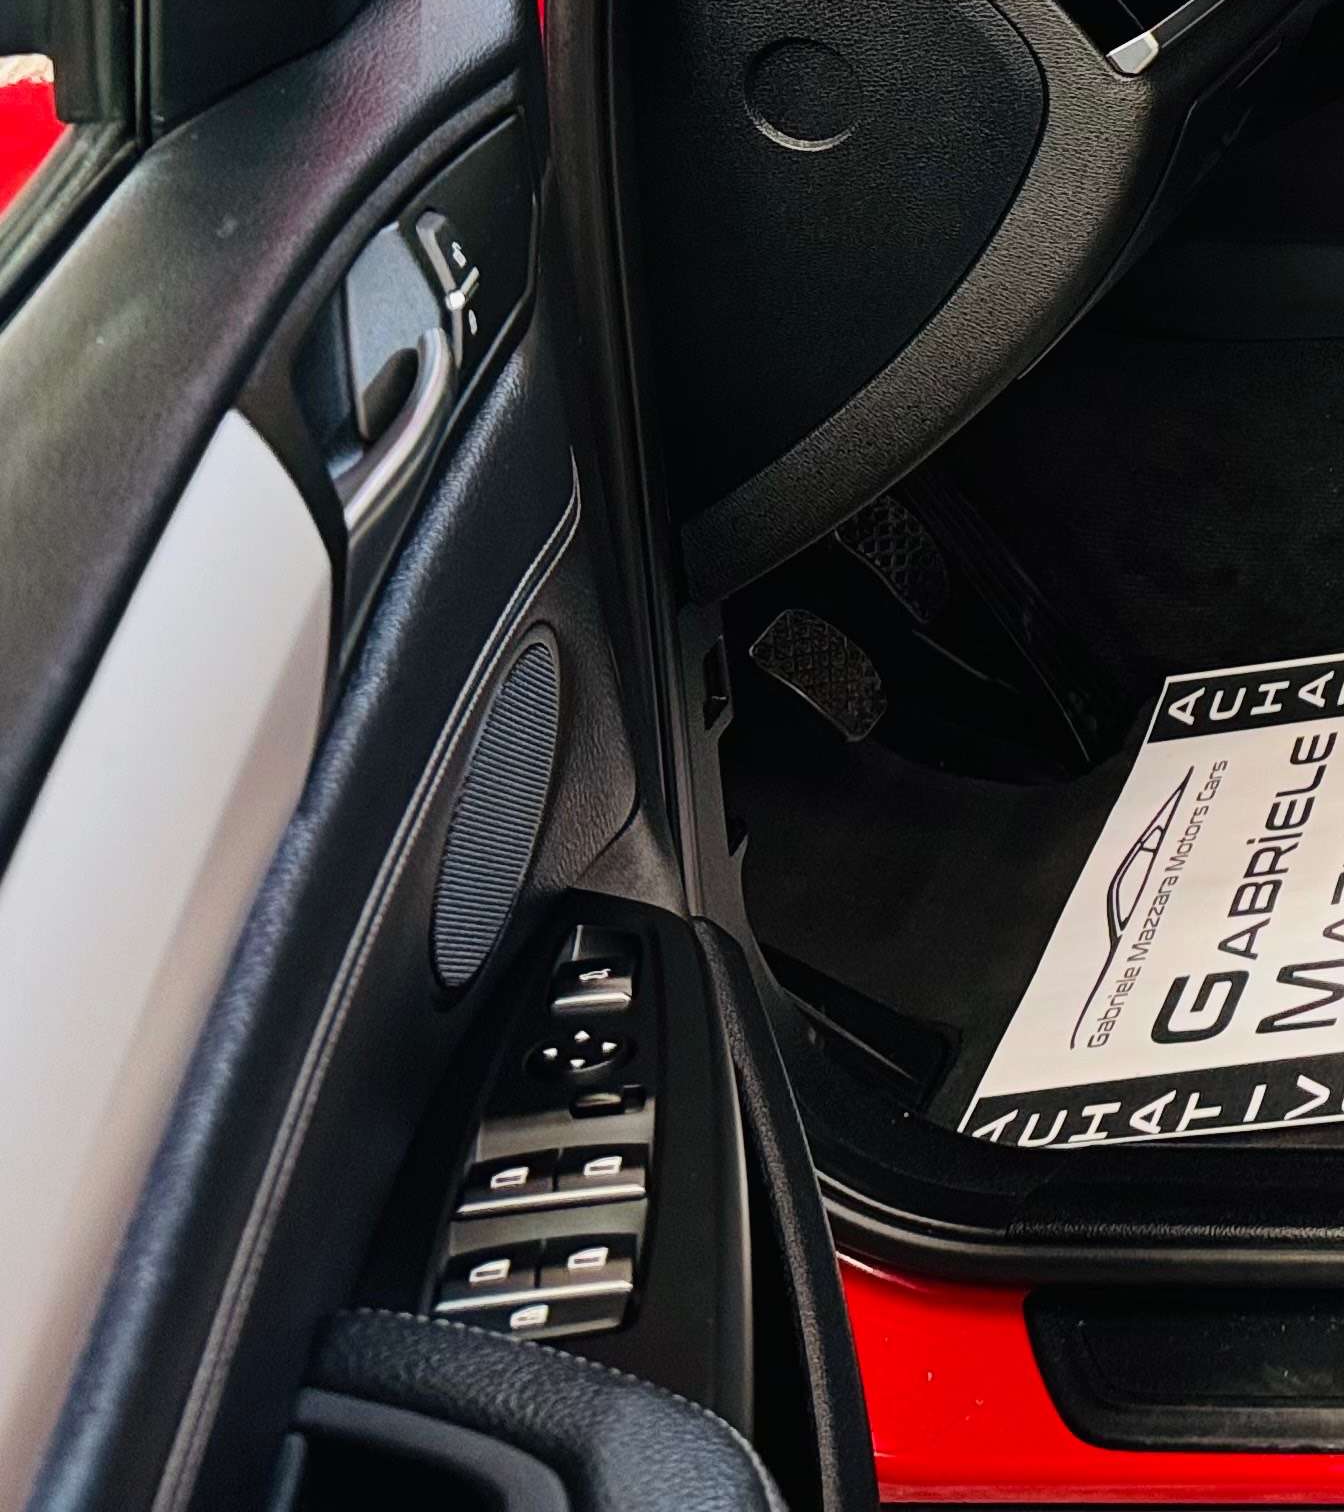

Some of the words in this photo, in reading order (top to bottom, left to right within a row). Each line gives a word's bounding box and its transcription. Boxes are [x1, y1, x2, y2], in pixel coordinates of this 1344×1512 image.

[1087, 966, 1142, 1048] Gabriele
[1127, 874, 1178, 963] Mazzara
[1165, 805, 1209, 872] Motors
[1196, 759, 1228, 802] Cars
